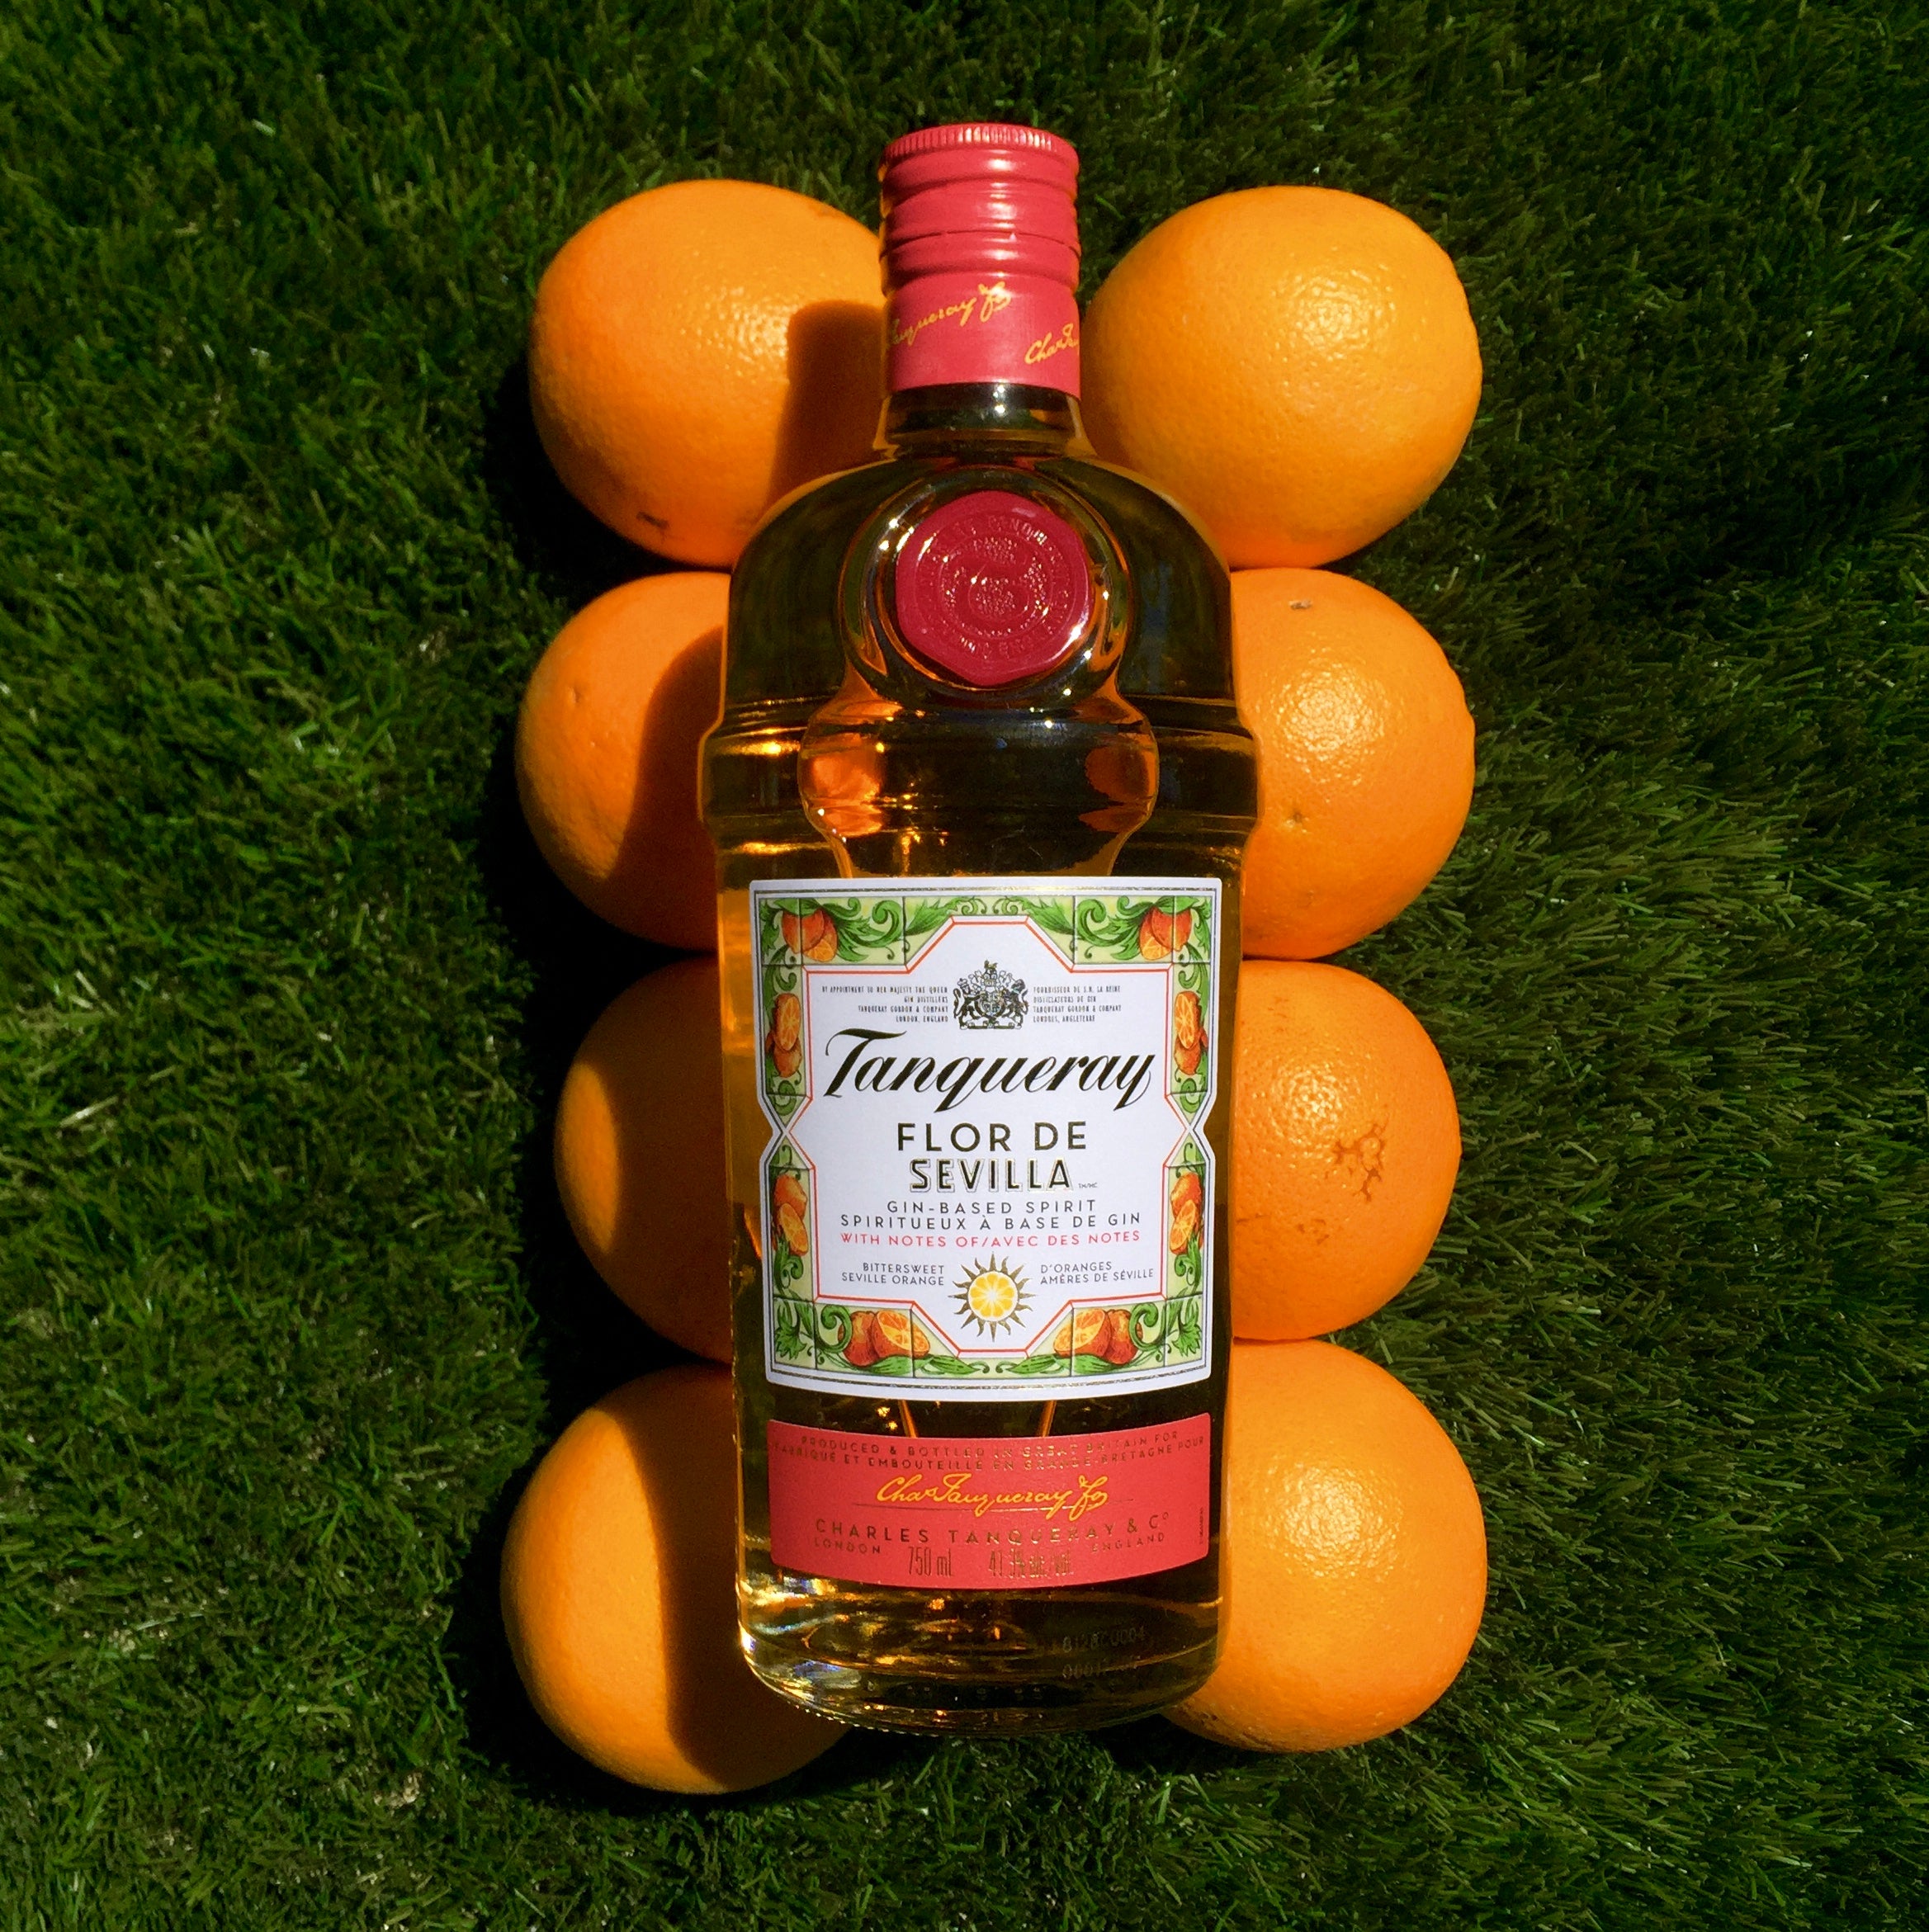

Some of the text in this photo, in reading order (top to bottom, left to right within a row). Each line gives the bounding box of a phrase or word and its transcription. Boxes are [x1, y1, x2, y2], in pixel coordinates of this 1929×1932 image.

[830, 985, 864, 994] APPOINTMENT
[877, 985, 886, 994] HER
[890, 985, 912, 994] MAJESTY
[915, 985, 925, 994] THE
[929, 985, 948, 994] QUEEN
[1073, 985, 1080, 994] DE
[1097, 985, 1103, 994] LA
[917, 995, 948, 1004] DISTILLERS
[858, 1005, 887, 1013] TANQUERAY
[1033, 1005, 1064, 1013] TANQUERAY
[1099, 1004, 1122, 1013] COMPANY
[1062, 1014, 1095, 1023] ANGLETERRE
[824, 1027, 1156, 1112] Tanqueray
[897, 1121, 1086, 1152] FLOR DE
[910, 1157, 1074, 1193] SEVILLA
[886, 1199, 1096, 1214] GIN-BASED SPIRIT
[841, 1212, 1140, 1230] SPIRITUEUX À BASE DE GIN
[840, 1232, 880, 1245] WITH
[888, 1235, 947, 1247] NOTES
[1047, 1234, 1080, 1246] DES
[1089, 1230, 1141, 1245] NOTES
[863, 1262, 945, 1274] BITTERSWEET
[1041, 1261, 1113, 1274] D'ORANGES
[841, 1272, 944, 1286] SEVILLE ORANGE
[1040, 1268, 1154, 1285] AMÈRES DE SÉVILLE
[801, 1436, 880, 1455] PRODUCED
[889, 1446, 897, 1455] &
[908, 1446, 985, 1458] BOTTLED
[1155, 1430, 1178, 1443] FOR
[844, 1455, 859, 1465] ET
[993, 1460, 1014, 1471] EN
[1178, 1436, 1204, 1452] POUR
[816, 1518, 929, 1543] CHARLES
[948, 1523, 1114, 1546] TANQUERAY
[1127, 1517, 1138, 1534] &
[814, 1531, 1165, 1555] LONDON ENGLAND
[908, 1546, 932, 1577] 750
[935, 1548, 954, 1577] ml
